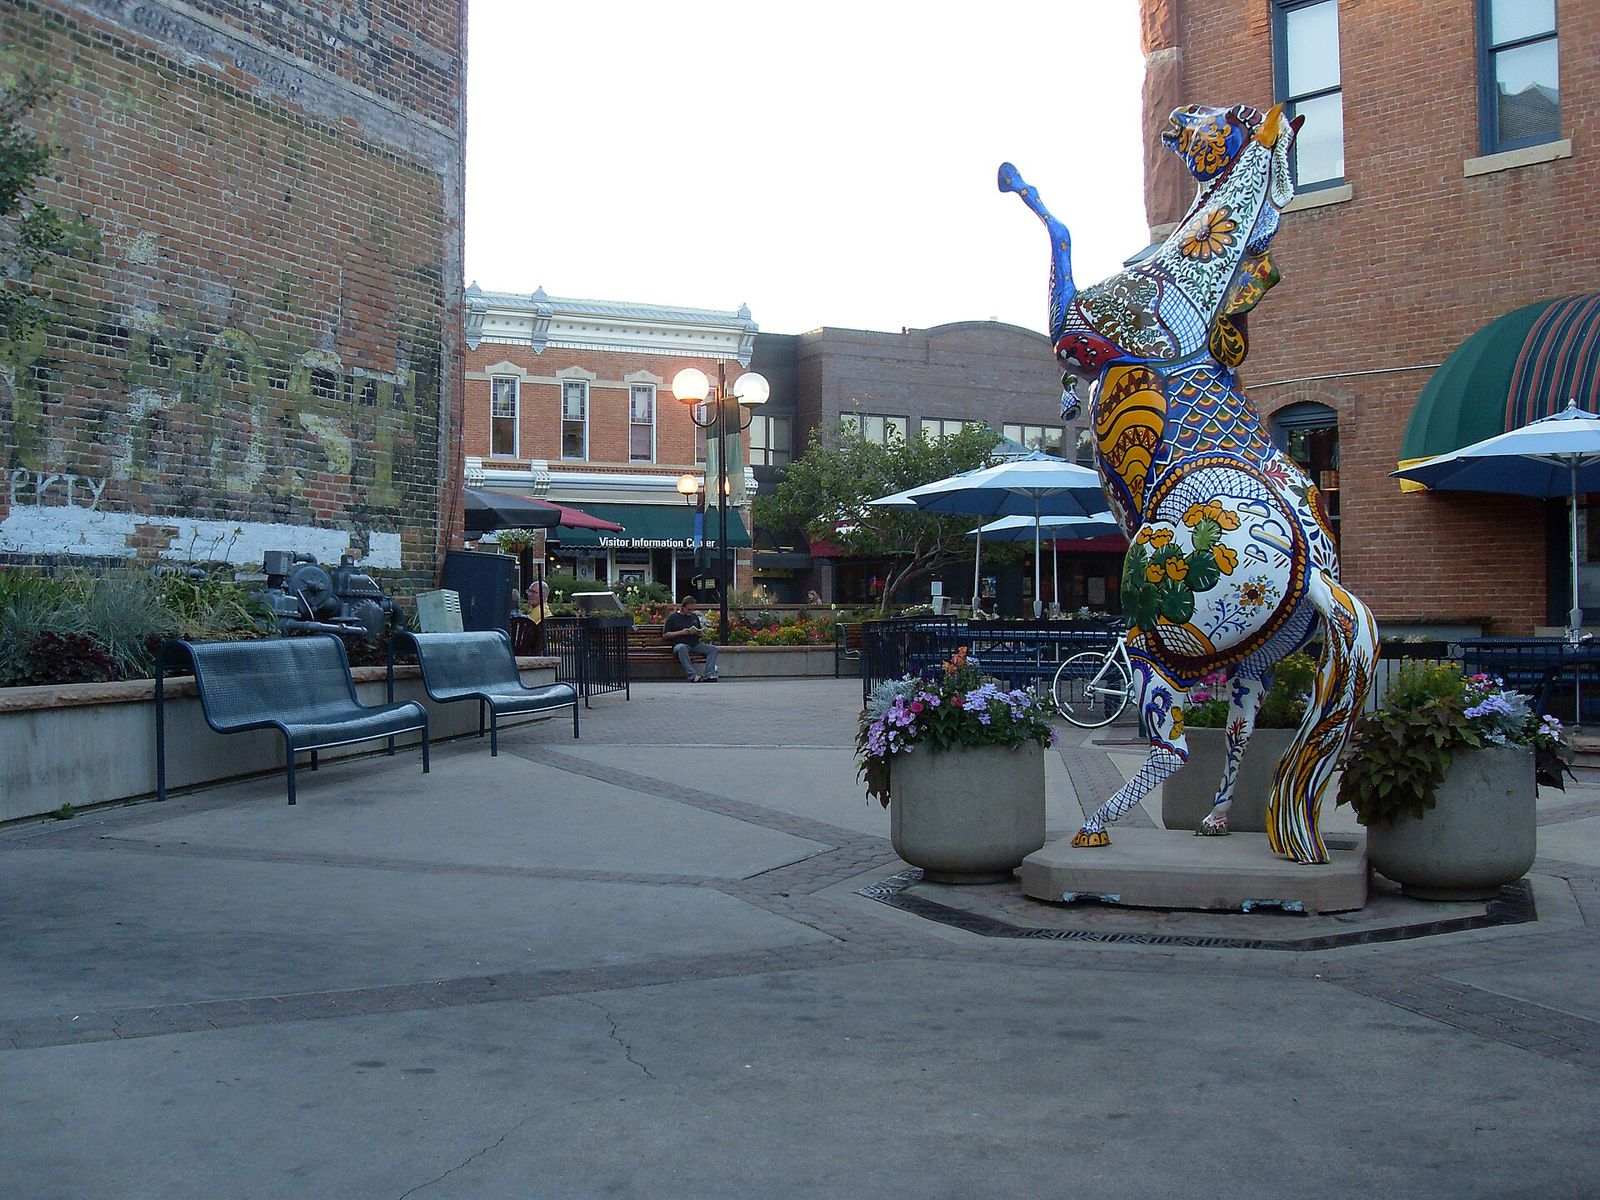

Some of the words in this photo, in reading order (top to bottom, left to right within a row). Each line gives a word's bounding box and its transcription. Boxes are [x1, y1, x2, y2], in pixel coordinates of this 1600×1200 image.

[599, 537, 629, 547] Visitor
[632, 538, 684, 547] Information
[686, 538, 715, 547] Cer
